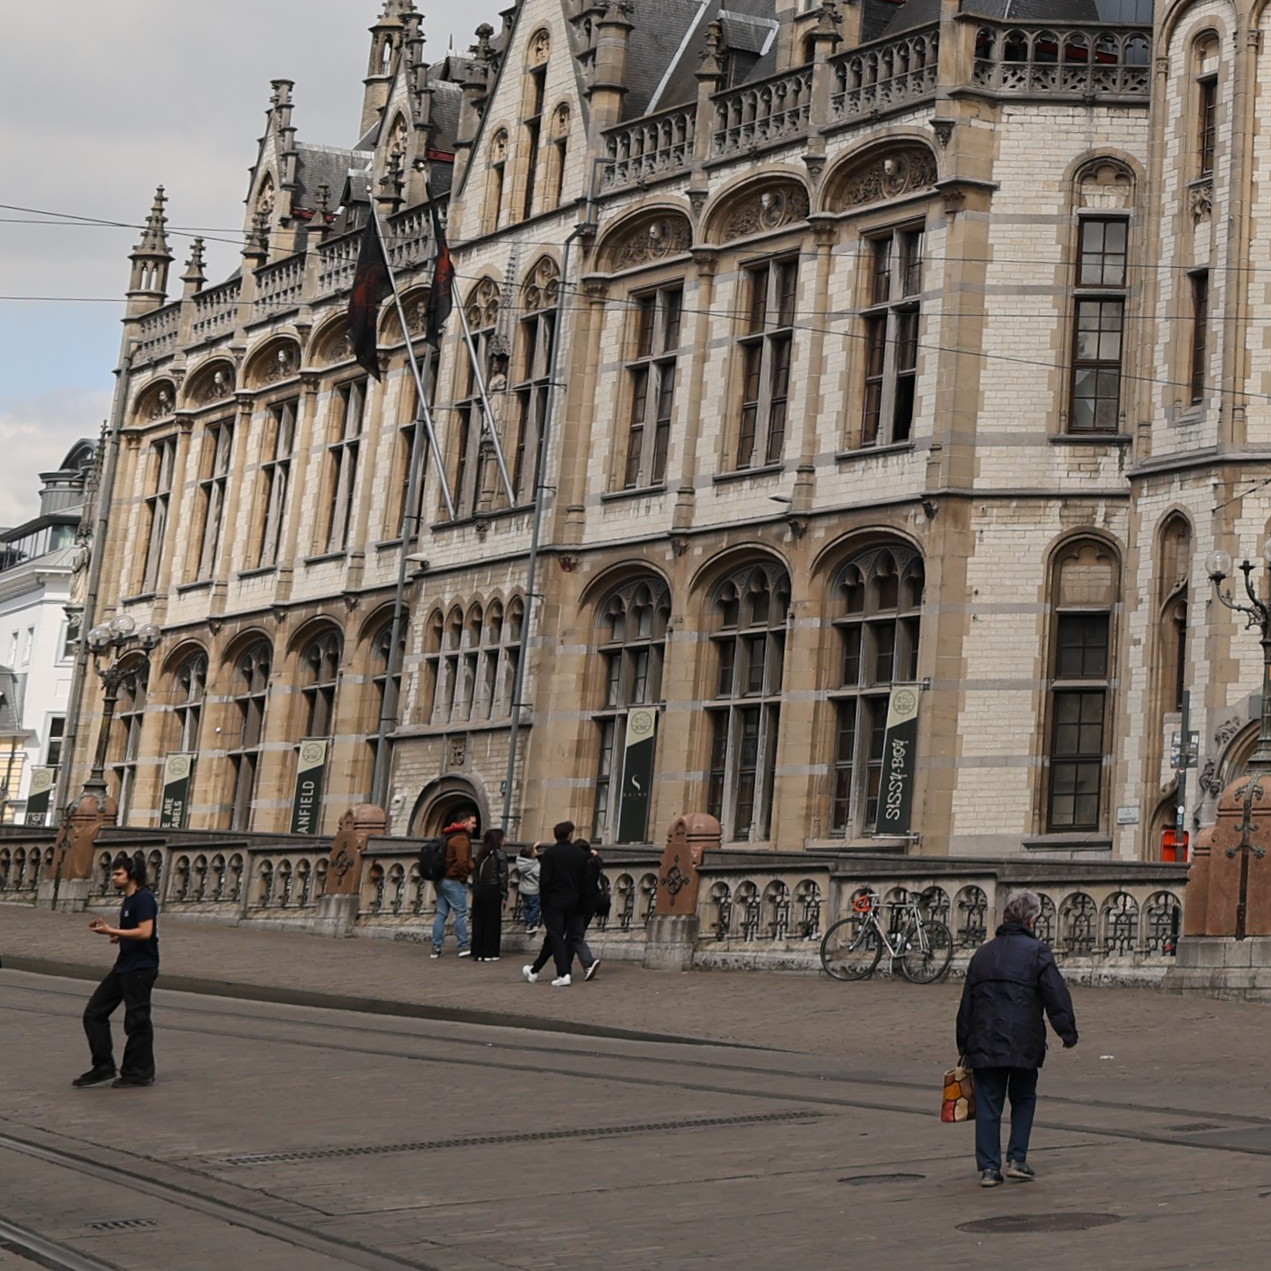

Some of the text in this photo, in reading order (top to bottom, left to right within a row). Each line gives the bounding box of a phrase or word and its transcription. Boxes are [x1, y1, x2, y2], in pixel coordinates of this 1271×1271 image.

[297, 780, 315, 834] ANFIELD
[885, 739, 909, 821] SISSY-BOY
[171, 800, 183, 829] ABELS
